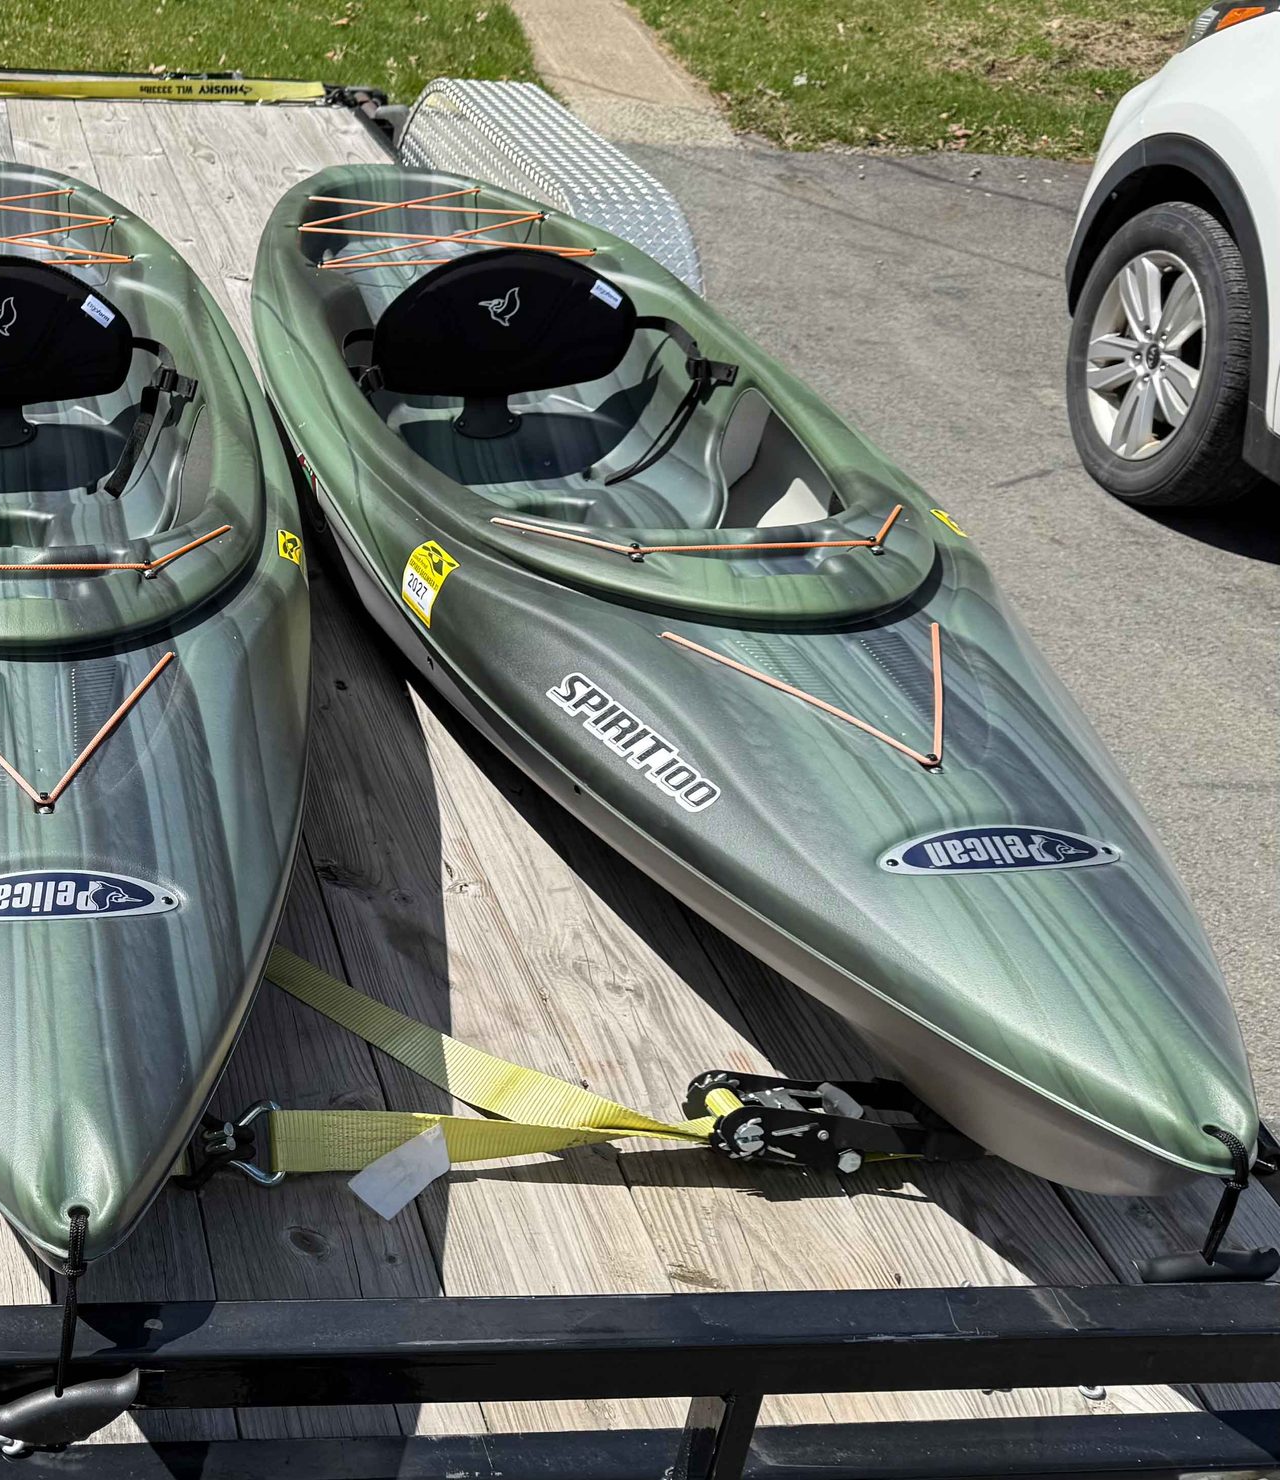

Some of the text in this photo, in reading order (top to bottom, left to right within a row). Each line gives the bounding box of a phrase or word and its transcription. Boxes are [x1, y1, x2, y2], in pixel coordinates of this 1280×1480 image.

[176, 85, 193, 94] WLL
[198, 85, 239, 95] HUSKY
[407, 573, 428, 600] 2027
[923, 835, 1060, 868] Pelican
